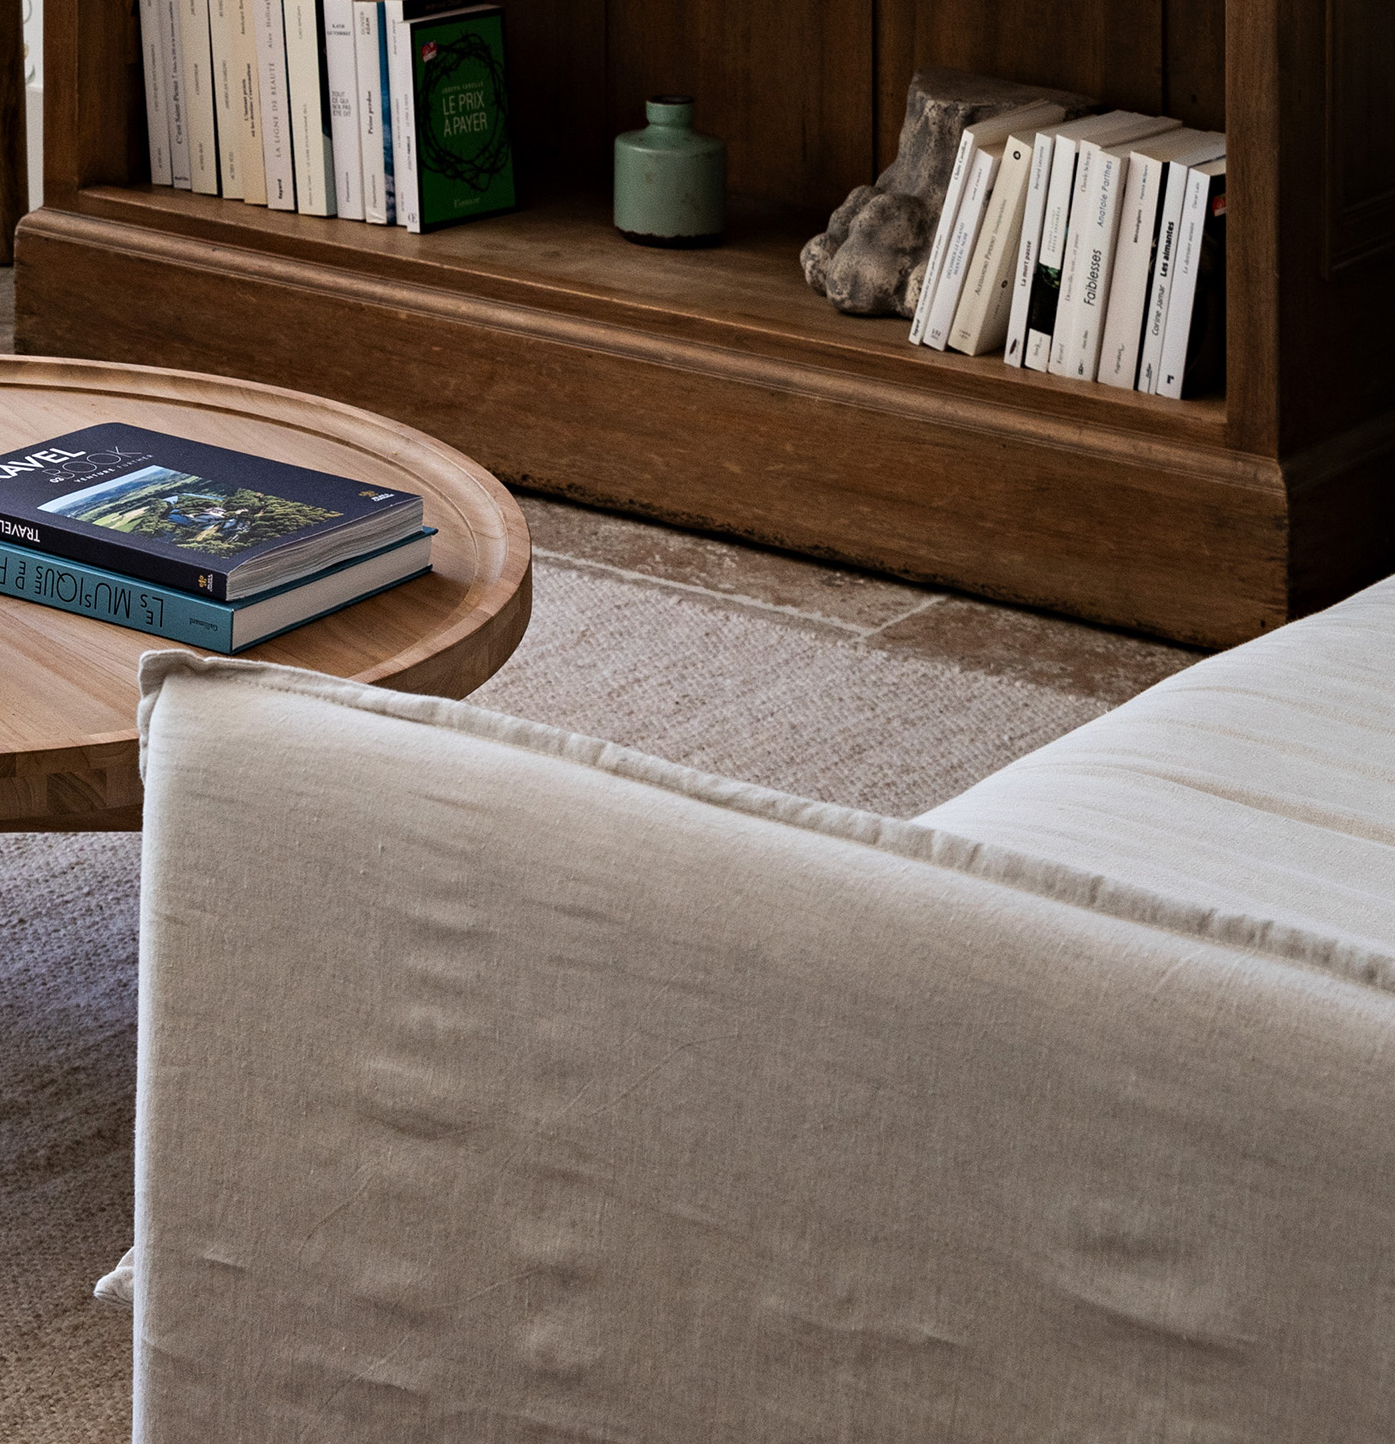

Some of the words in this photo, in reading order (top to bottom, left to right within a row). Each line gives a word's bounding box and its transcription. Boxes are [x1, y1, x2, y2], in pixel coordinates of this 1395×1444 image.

[271, 99, 279, 111] DE
[366, 91, 374, 115] perdue
[442, 95, 456, 116] LE
[458, 90, 486, 113] PRIX
[272, 115, 282, 144] LIGNE
[443, 118, 452, 138] À
[453, 111, 488, 136] PAYER
[274, 146, 282, 157] LA
[1100, 160, 1113, 192] Parthes
[1096, 193, 1109, 228] Anatole
[1160, 221, 1175, 261] aimantes
[1021, 260, 1031, 277] mort
[1082, 248, 1103, 307] Faiblesses
[1159, 263, 1169, 277] Les
[1019, 277, 1027, 287] La
[1154, 284, 1166, 309] Jamar
[1151, 310, 1162, 336] Corine
[41, 446, 143, 481] BOOK
[74, 468, 116, 484] VENTURE
[116, 454, 154, 470] FURTHER
